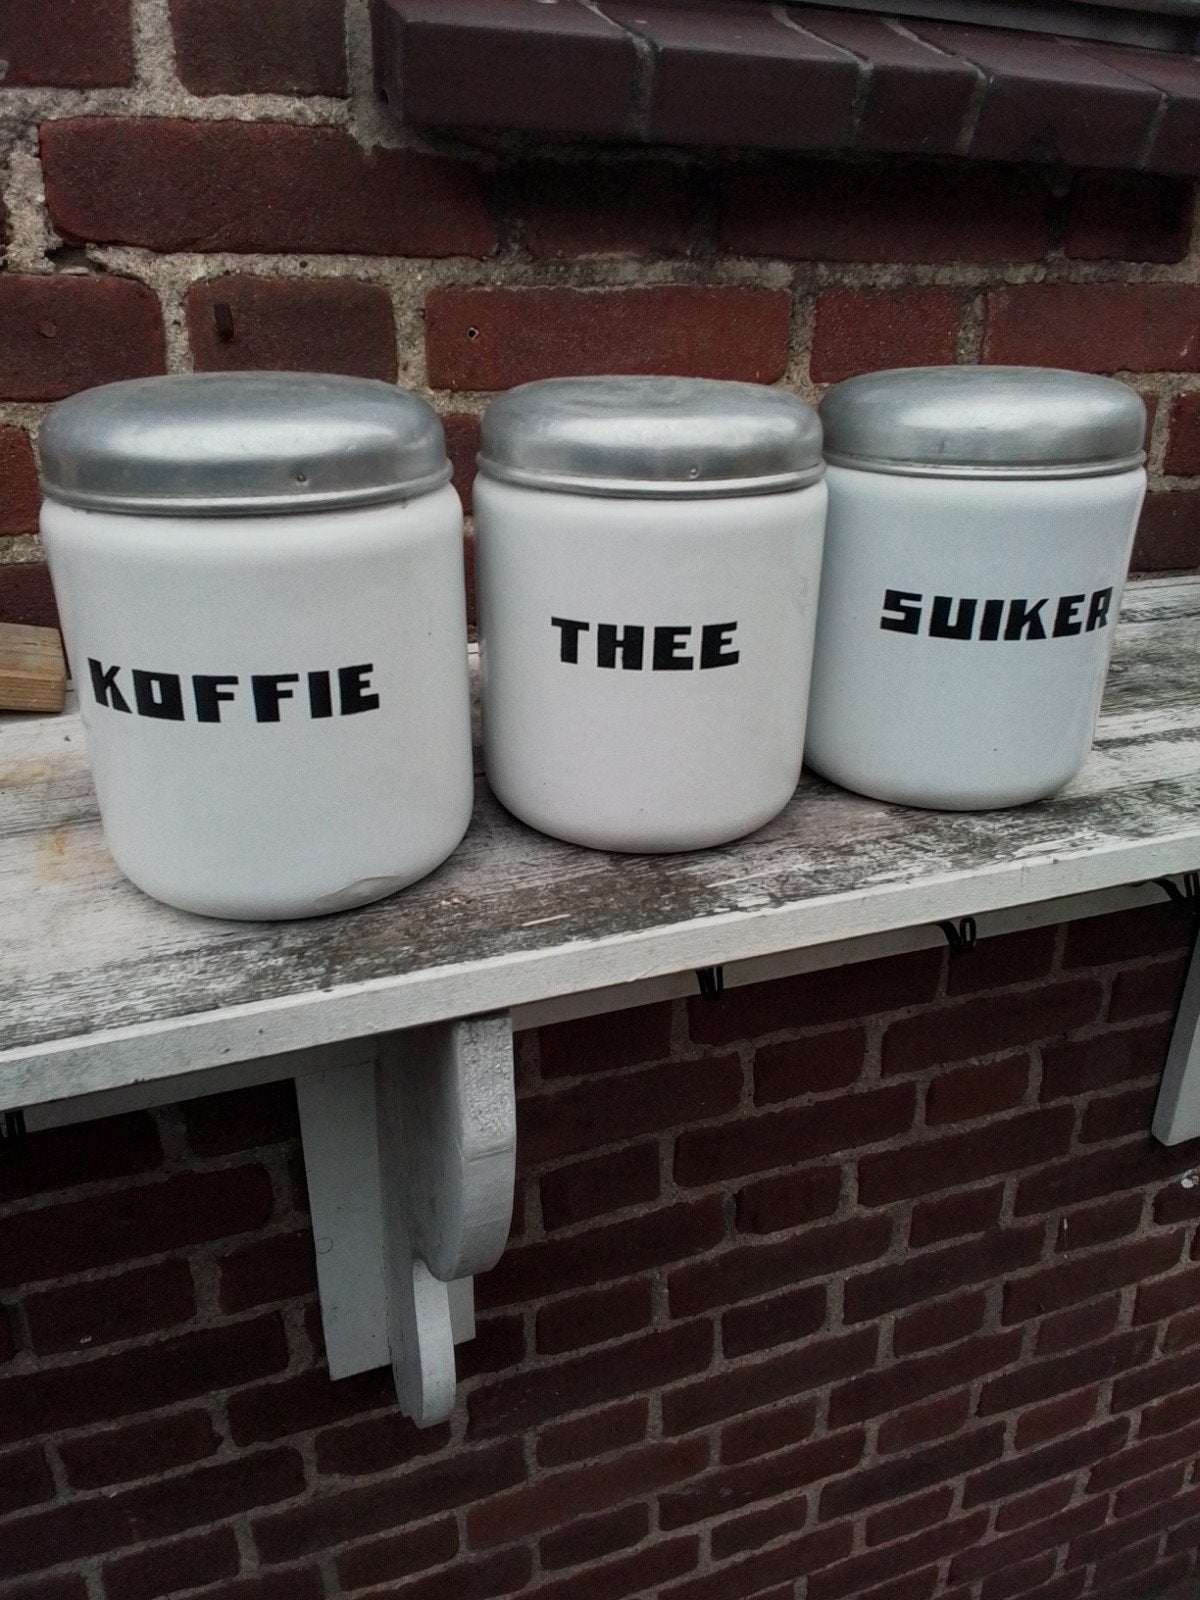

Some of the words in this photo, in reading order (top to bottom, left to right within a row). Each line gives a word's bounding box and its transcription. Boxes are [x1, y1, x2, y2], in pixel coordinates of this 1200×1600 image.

[879, 586, 1113, 642] SUIKER
[551, 616, 739, 671] THEE
[87, 657, 380, 723] KOFFIE
